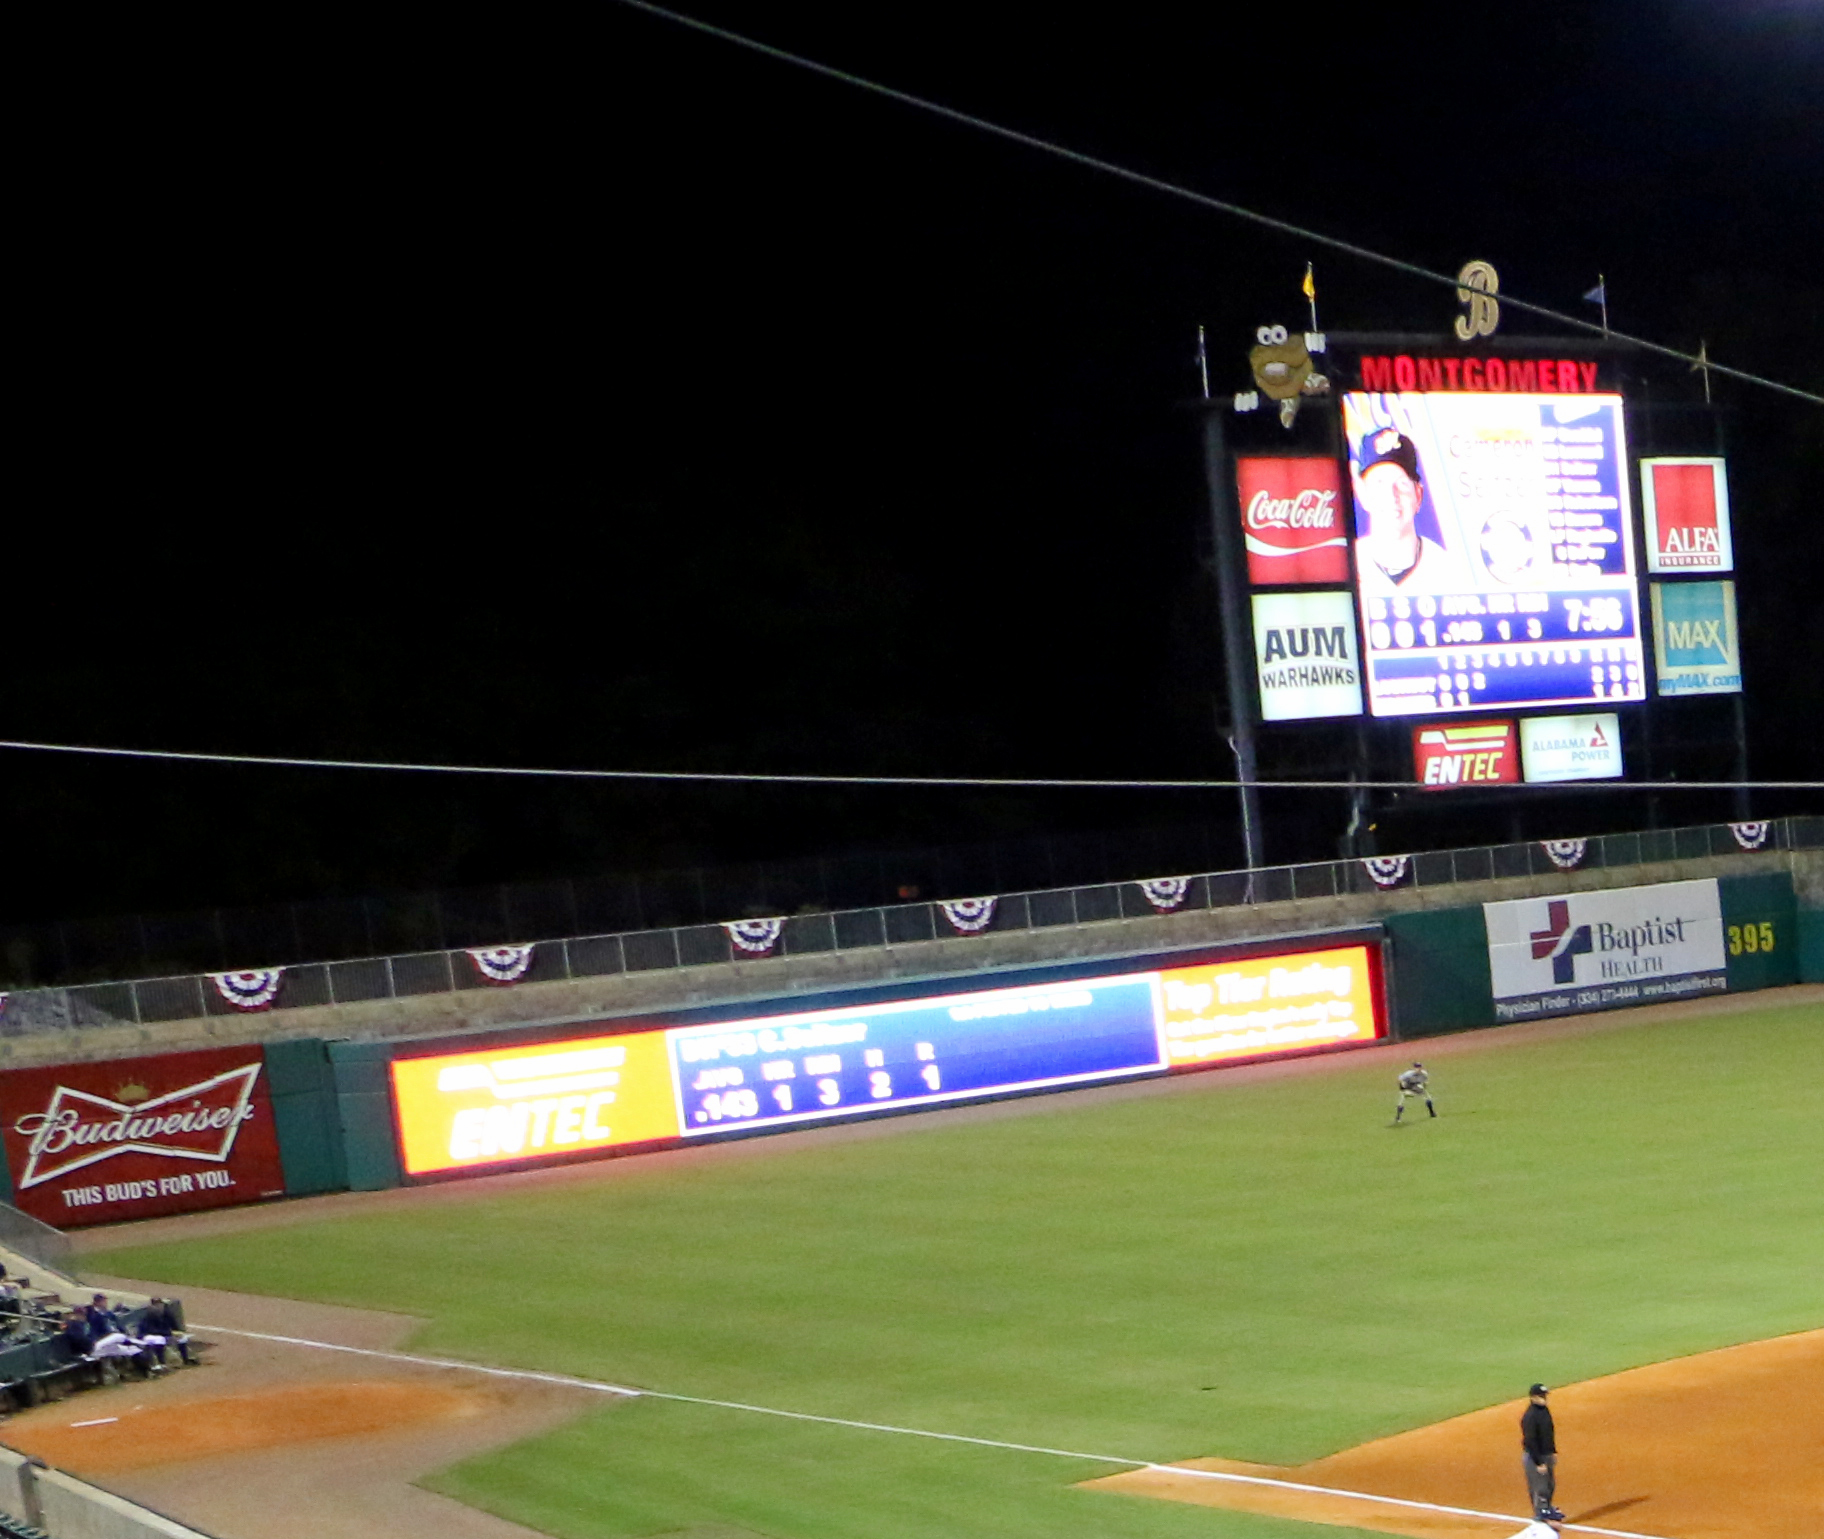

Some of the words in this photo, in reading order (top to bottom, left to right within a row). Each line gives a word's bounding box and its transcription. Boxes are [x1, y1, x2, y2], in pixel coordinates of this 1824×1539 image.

[1360, 355, 1597, 391] MONTGOMERY
[1246, 489, 1337, 529] Coca-Cola
[1665, 527, 1719, 553] ALFA
[1660, 555, 1719, 566] INSURANCE
[1264, 626, 1348, 664] AUM
[1668, 620, 1727, 657] MAX
[1262, 665, 1355, 690] WARHAWKS
[1659, 673, 1742, 692] myMAX.com
[1532, 738, 1586, 752] ALABAMA
[1572, 749, 1610, 762] POWER
[1424, 751, 1503, 785] ENTEC
[1597, 916, 1686, 956] Baptist
[1728, 922, 1775, 955] 395
[1601, 957, 1663, 978] HEALTH
[1496, 999, 1541, 1018] Physician
[1542, 996, 1570, 1010] Finder
[773, 1084, 792, 1111] 1
[818, 1078, 840, 1105] 3
[869, 1071, 892, 1098] 2
[921, 1064, 941, 1090] 1
[14, 1100, 254, 1154] Budweiser
[449, 1091, 616, 1160] ENTEC
[62, 1187, 103, 1207] THIS
[106, 1179, 157, 1202] BUD'S
[160, 1174, 194, 1195] FOR
[198, 1170, 236, 1191] YOU.
